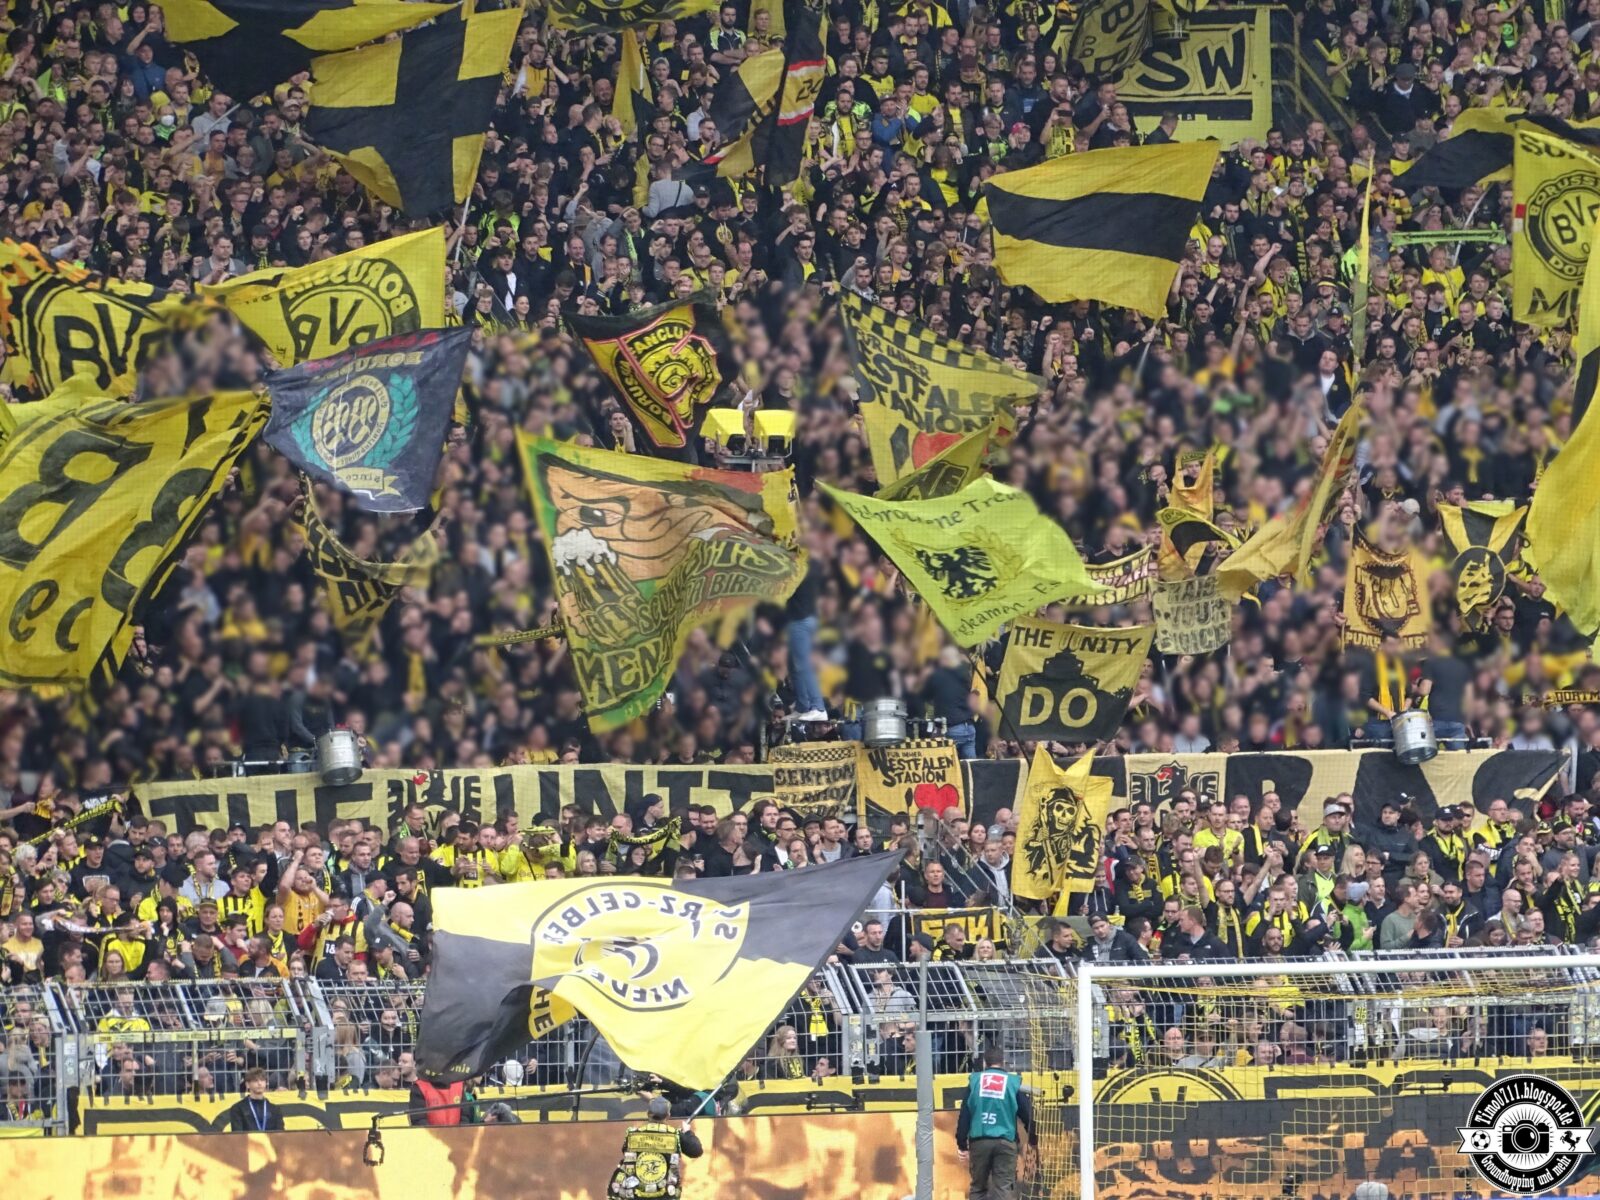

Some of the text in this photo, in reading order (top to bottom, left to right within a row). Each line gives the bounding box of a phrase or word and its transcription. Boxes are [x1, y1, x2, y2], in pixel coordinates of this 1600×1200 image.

[1013, 626, 1142, 655] THE UNITY
[1020, 686, 1098, 728] DO
[882, 768, 946, 788] STADION
[982, 1113, 997, 1125] 25
